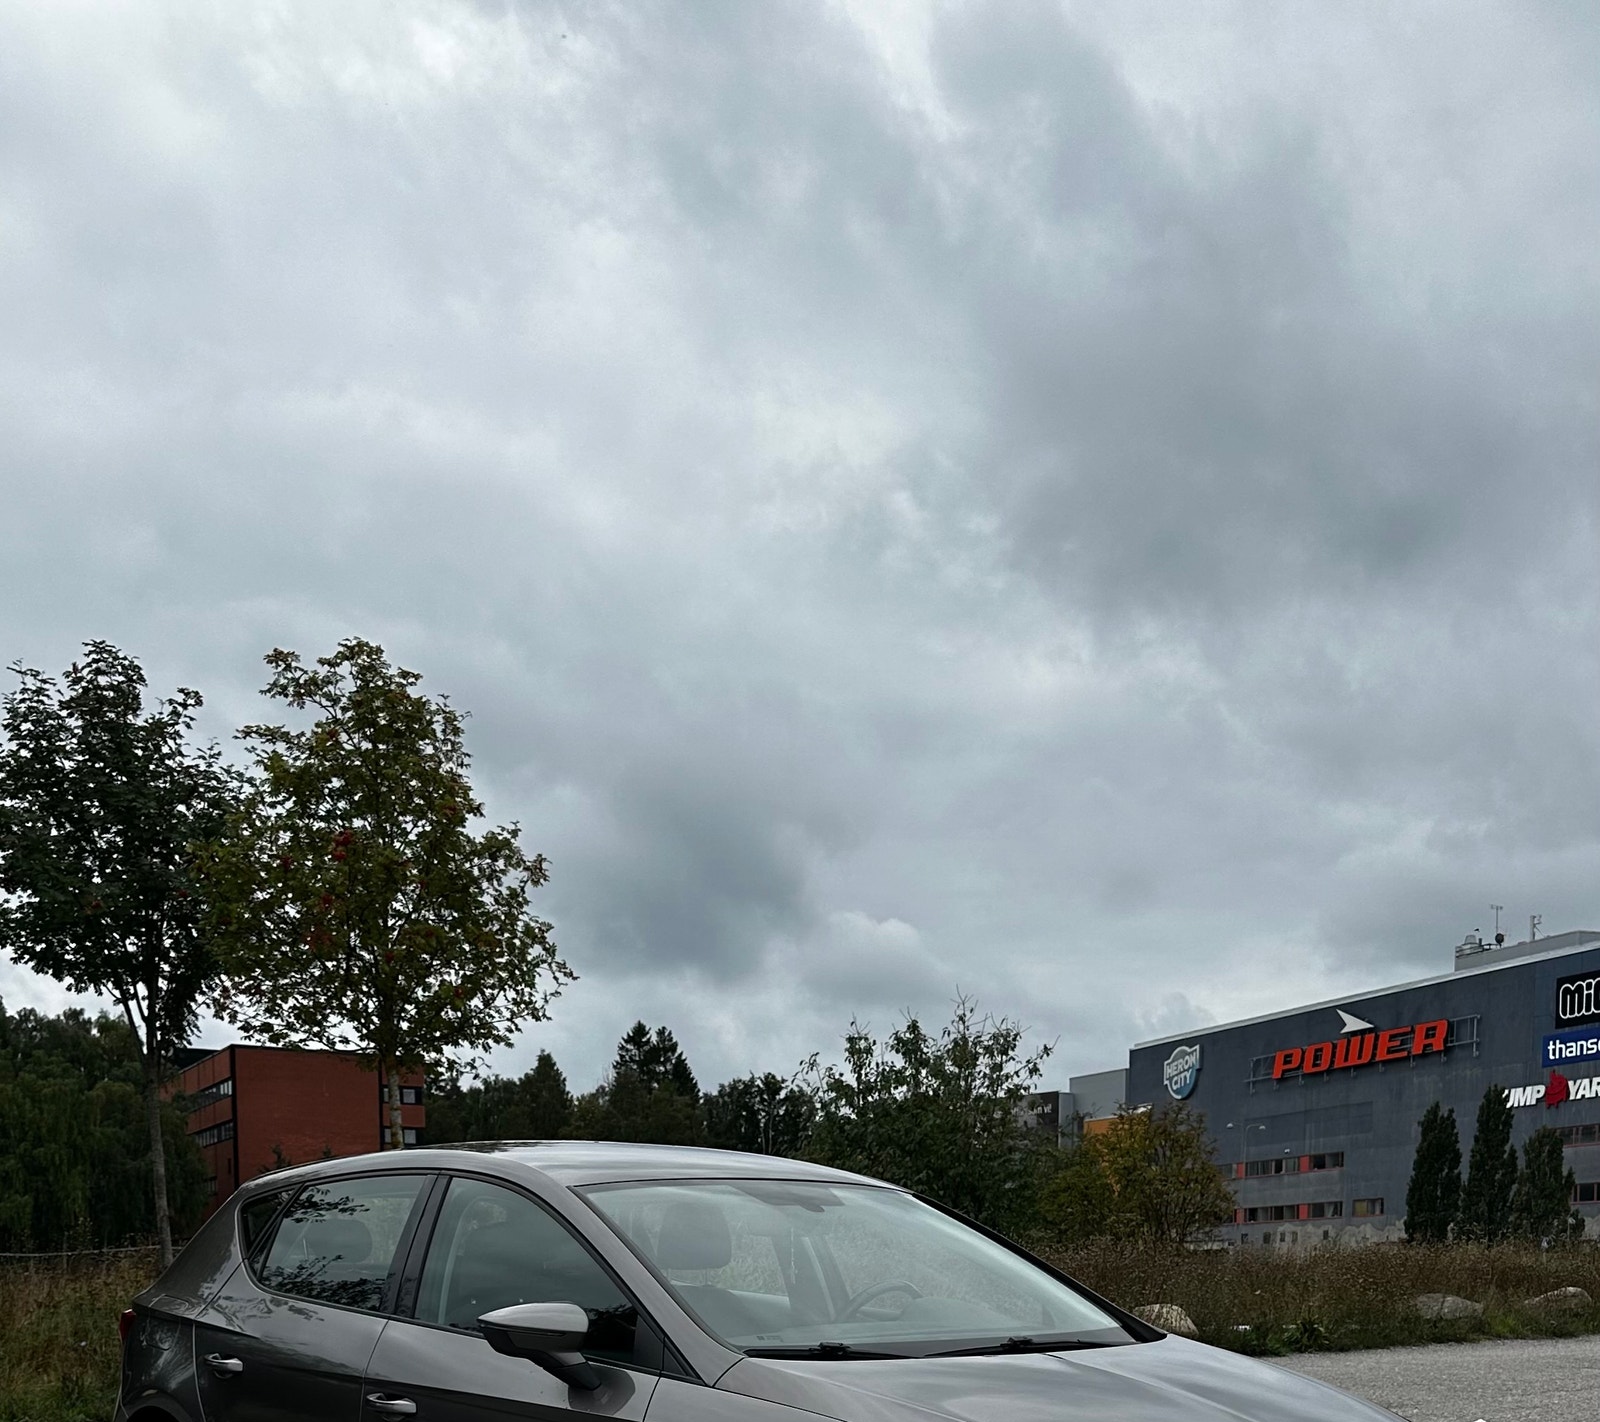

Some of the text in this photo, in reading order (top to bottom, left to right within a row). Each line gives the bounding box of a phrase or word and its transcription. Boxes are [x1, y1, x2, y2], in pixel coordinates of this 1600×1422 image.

[1272, 1019, 1448, 1079] POWER
[1547, 1038, 1600, 1060] thans
[1166, 1052, 1196, 1079] HERON
[1172, 1069, 1192, 1090] CITY
[1502, 1084, 1546, 1109] UMP
